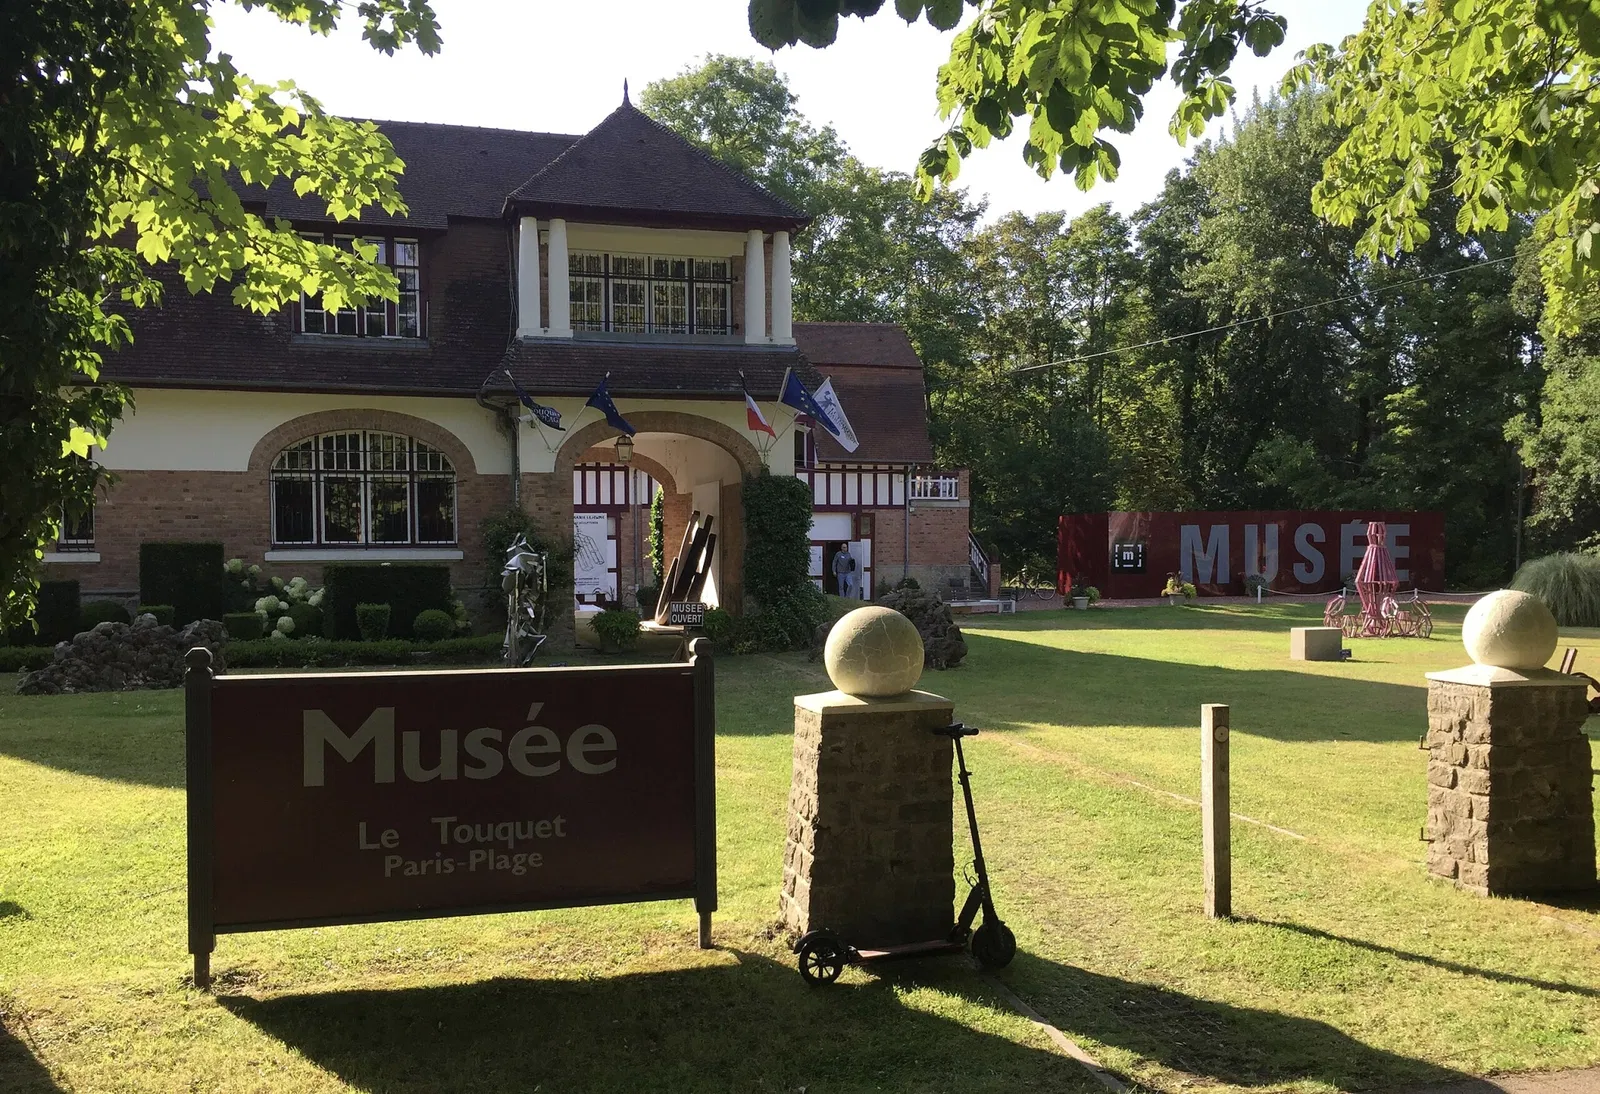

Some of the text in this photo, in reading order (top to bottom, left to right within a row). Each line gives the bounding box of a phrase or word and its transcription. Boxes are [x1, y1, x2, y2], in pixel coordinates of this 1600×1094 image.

[1180, 519, 1410, 584] MUSÉE
[671, 613, 702, 623] OUVERT
[672, 603, 703, 613] MUSEE
[303, 702, 618, 787] Musée
[359, 814, 567, 850] Le Touquet
[384, 849, 544, 878] Paris-Plage
